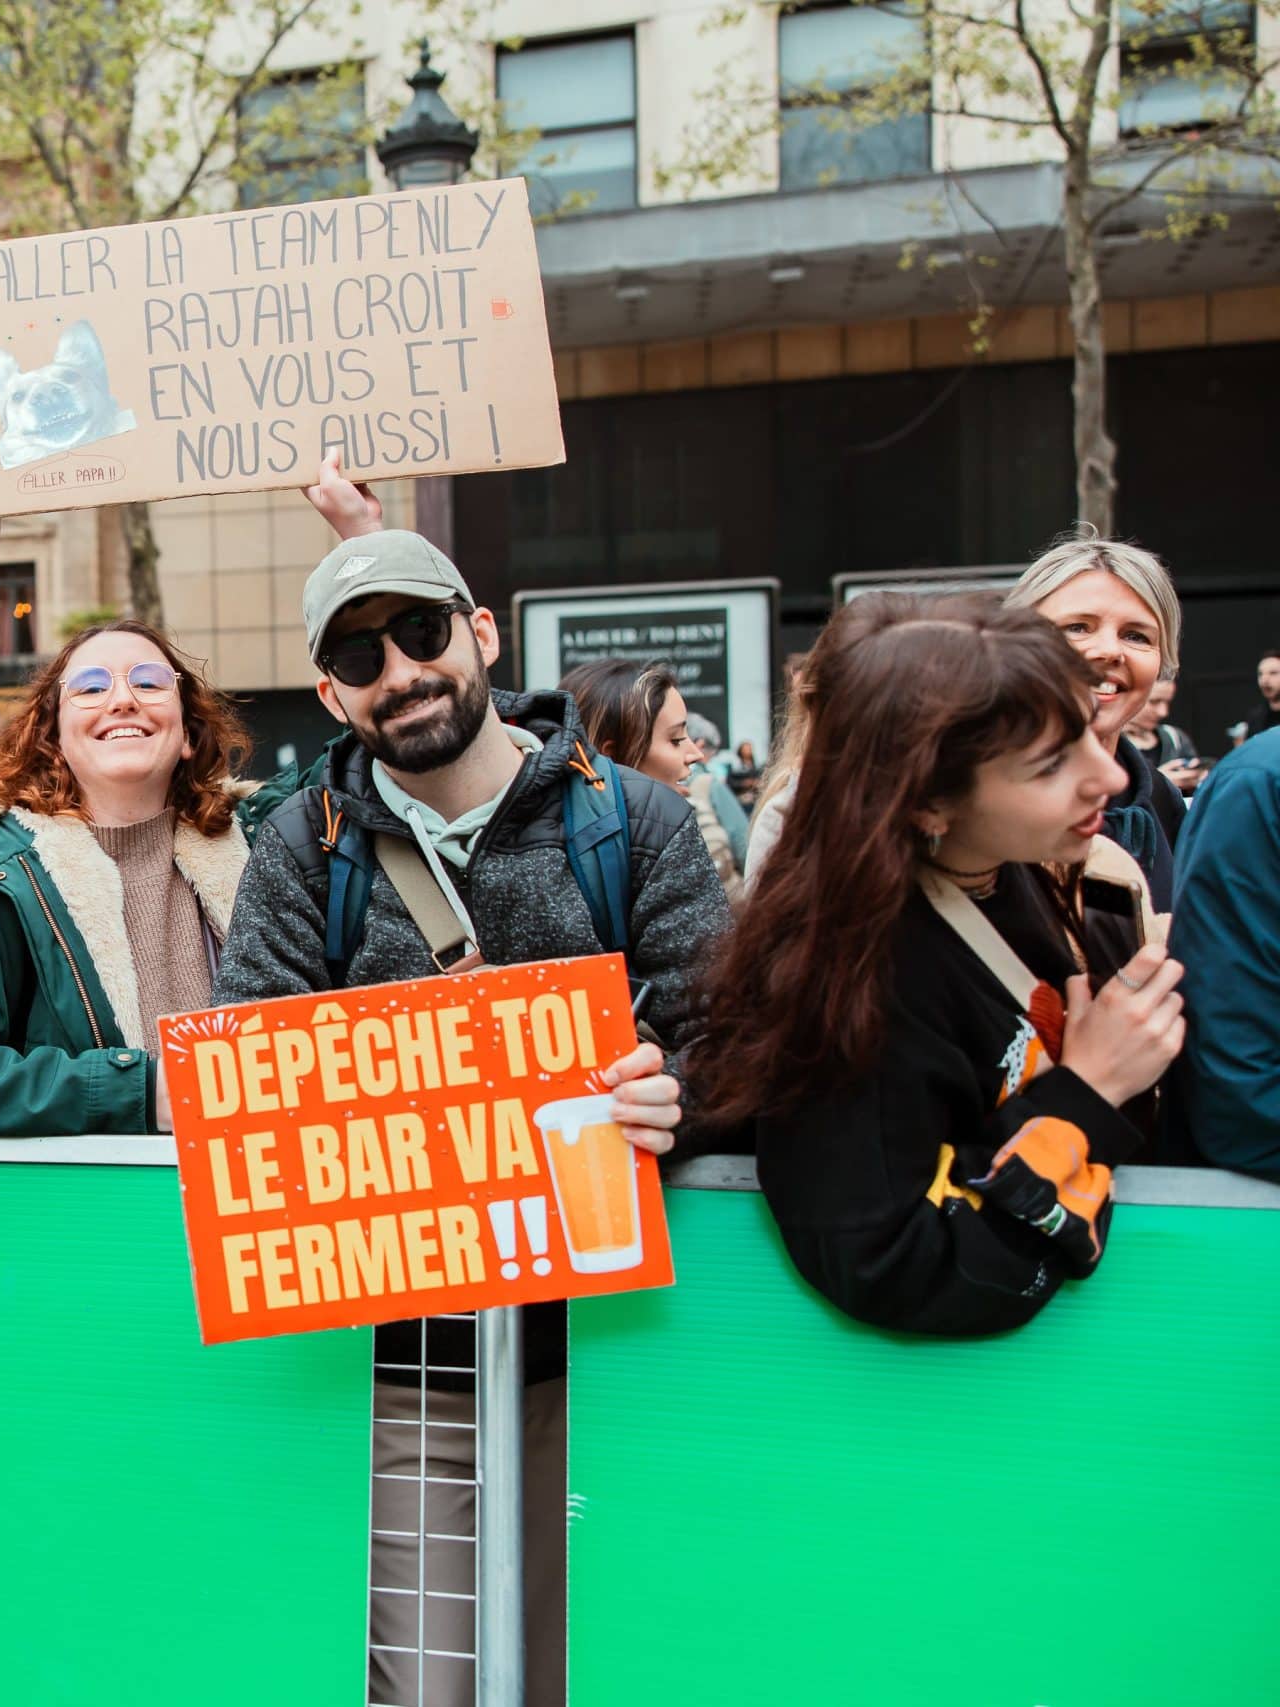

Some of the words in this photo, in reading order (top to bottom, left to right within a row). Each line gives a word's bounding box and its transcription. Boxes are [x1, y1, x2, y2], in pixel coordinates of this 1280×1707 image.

[145, 226, 183, 288] LA
[214, 207, 340, 275] TEAM
[355, 190, 507, 262] PENLY
[145, 282, 313, 355] RAJAH
[149, 361, 213, 421] EN
[239, 348, 375, 410] VOUS
[405, 337, 478, 397] ET
[23, 472, 66, 489] ALLER
[76, 467, 104, 482] PAPA
[176, 419, 298, 484] NOUS
[193, 1002, 481, 1120] DÉPÊCHE
[491, 989, 597, 1079] TOI
[208, 1131, 286, 1217] LE
[299, 1112, 432, 1205] BAR
[445, 1097, 540, 1184] VA
